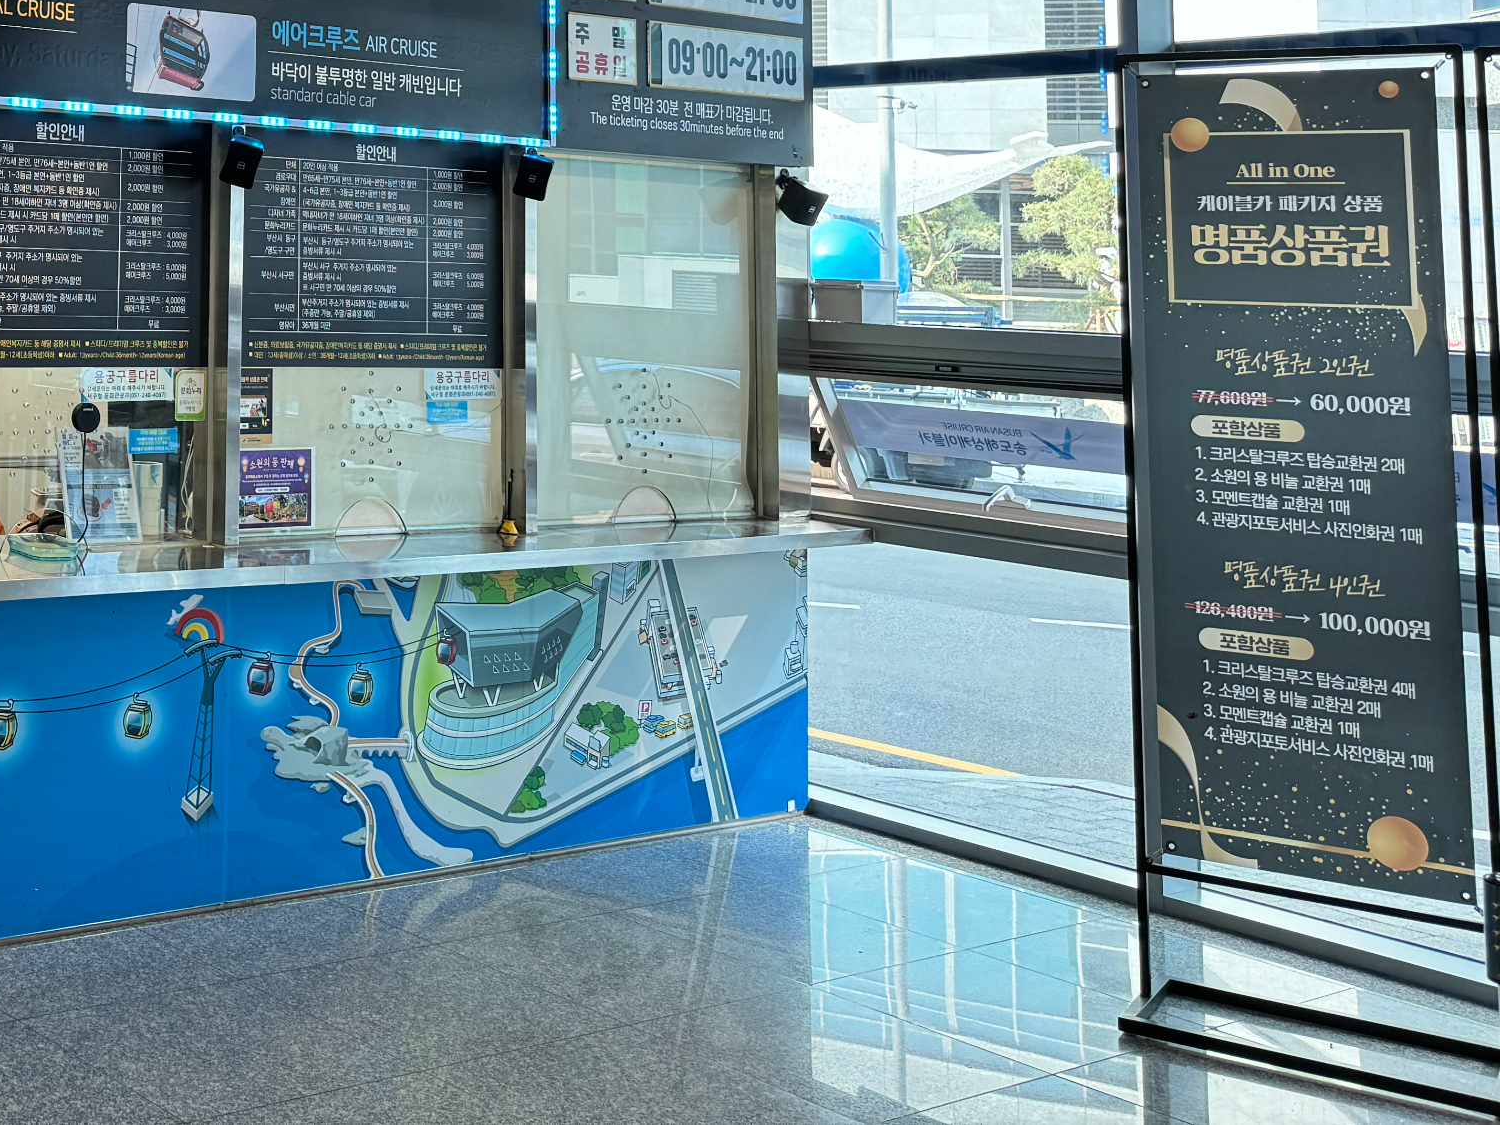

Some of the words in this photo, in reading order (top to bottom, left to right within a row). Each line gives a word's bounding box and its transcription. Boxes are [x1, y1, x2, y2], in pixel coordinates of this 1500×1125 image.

[273, 21, 360, 51] 에어크루즈
[366, 36, 387, 53] AIR
[391, 38, 437, 58] CRUISE
[272, 62, 310, 83] 바닥이
[315, 66, 367, 88] 불투명한
[371, 71, 396, 91] 일반
[400, 74, 462, 97] 캐빈입니다
[271, 87, 323, 103] standard
[327, 91, 356, 106] cable
[359, 96, 376, 107] car
[36, 122, 84, 142] 할인안내
[590, 112, 607, 124] The
[609, 114, 647, 130] ticketing
[650, 117, 677, 130] closes
[680, 120, 723, 134] 30minutes
[726, 124, 751, 137] before
[754, 126, 766, 138] the
[769, 128, 783, 140] end
[356, 144, 396, 162] 할인안내
[1236, 162, 1263, 177] All
[1269, 163, 1289, 177] in
[1294, 164, 1335, 177] One
[1197, 194, 1273, 212] 케이블카
[1278, 195, 1336, 213] 패키지
[1343, 195, 1383, 213] 상품
[1190, 222, 1390, 266] 명품상품권
[1216, 348, 1316, 377] 명품상품권
[1319, 356, 1374, 377] 2인권
[95, 369, 158, 383] 용궁구름다리
[437, 371, 489, 383] 용궁구름다리
[1310, 394, 1411, 416] 60,000원
[1212, 420, 1280, 438] 포함상품
[1196, 446, 1206, 459] 1.
[1210, 447, 1304, 466] 크리스탈크루즈
[1307, 453, 1377, 472] 탑승교환권
[1381, 458, 1405, 475] 2매
[1224, 561, 1325, 592] 명품상품권
[1330, 575, 1385, 597] 4인권
[1319, 612, 1431, 640] 100,000원
